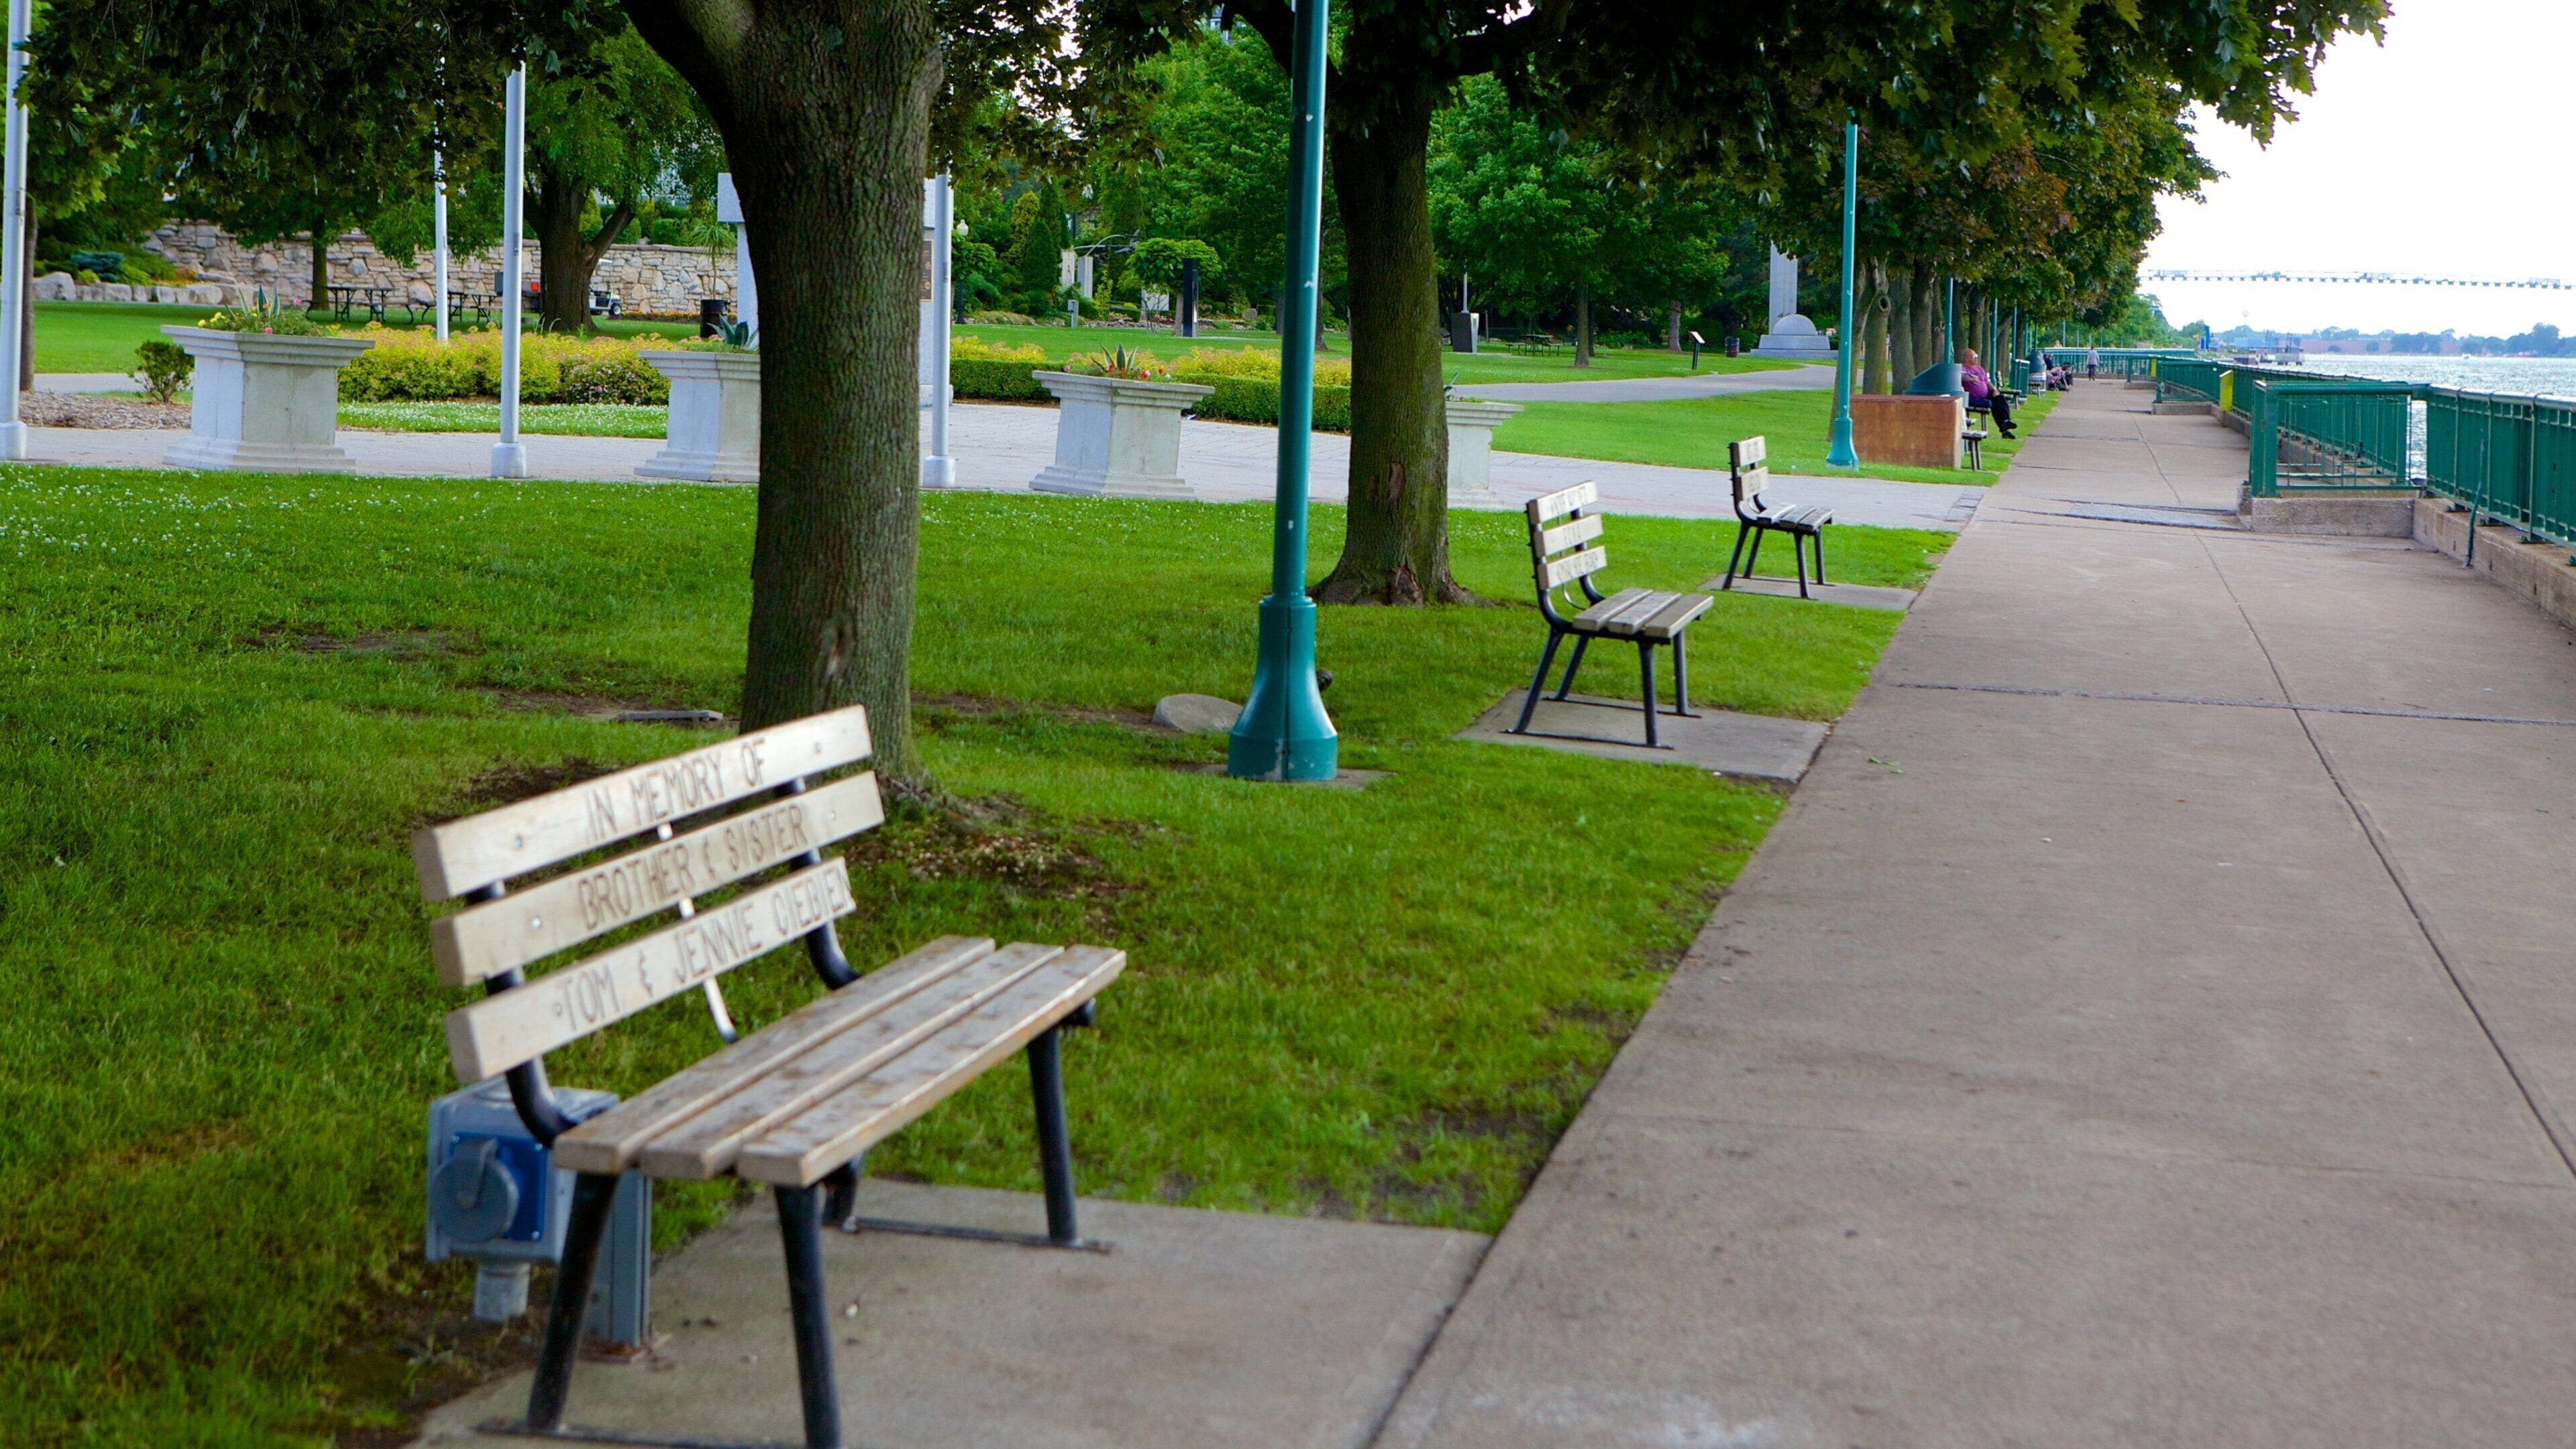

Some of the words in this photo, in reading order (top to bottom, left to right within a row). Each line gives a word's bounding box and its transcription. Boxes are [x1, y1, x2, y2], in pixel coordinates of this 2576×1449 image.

[584, 787, 619, 840] IN
[628, 750, 724, 826] MEMORY
[742, 737, 765, 788] OF
[578, 842, 696, 930] BROTHER
[726, 806, 808, 871] SISTER
[557, 963, 621, 1030] TOM
[638, 948, 653, 997] &
[674, 903, 763, 984] JENNIE
